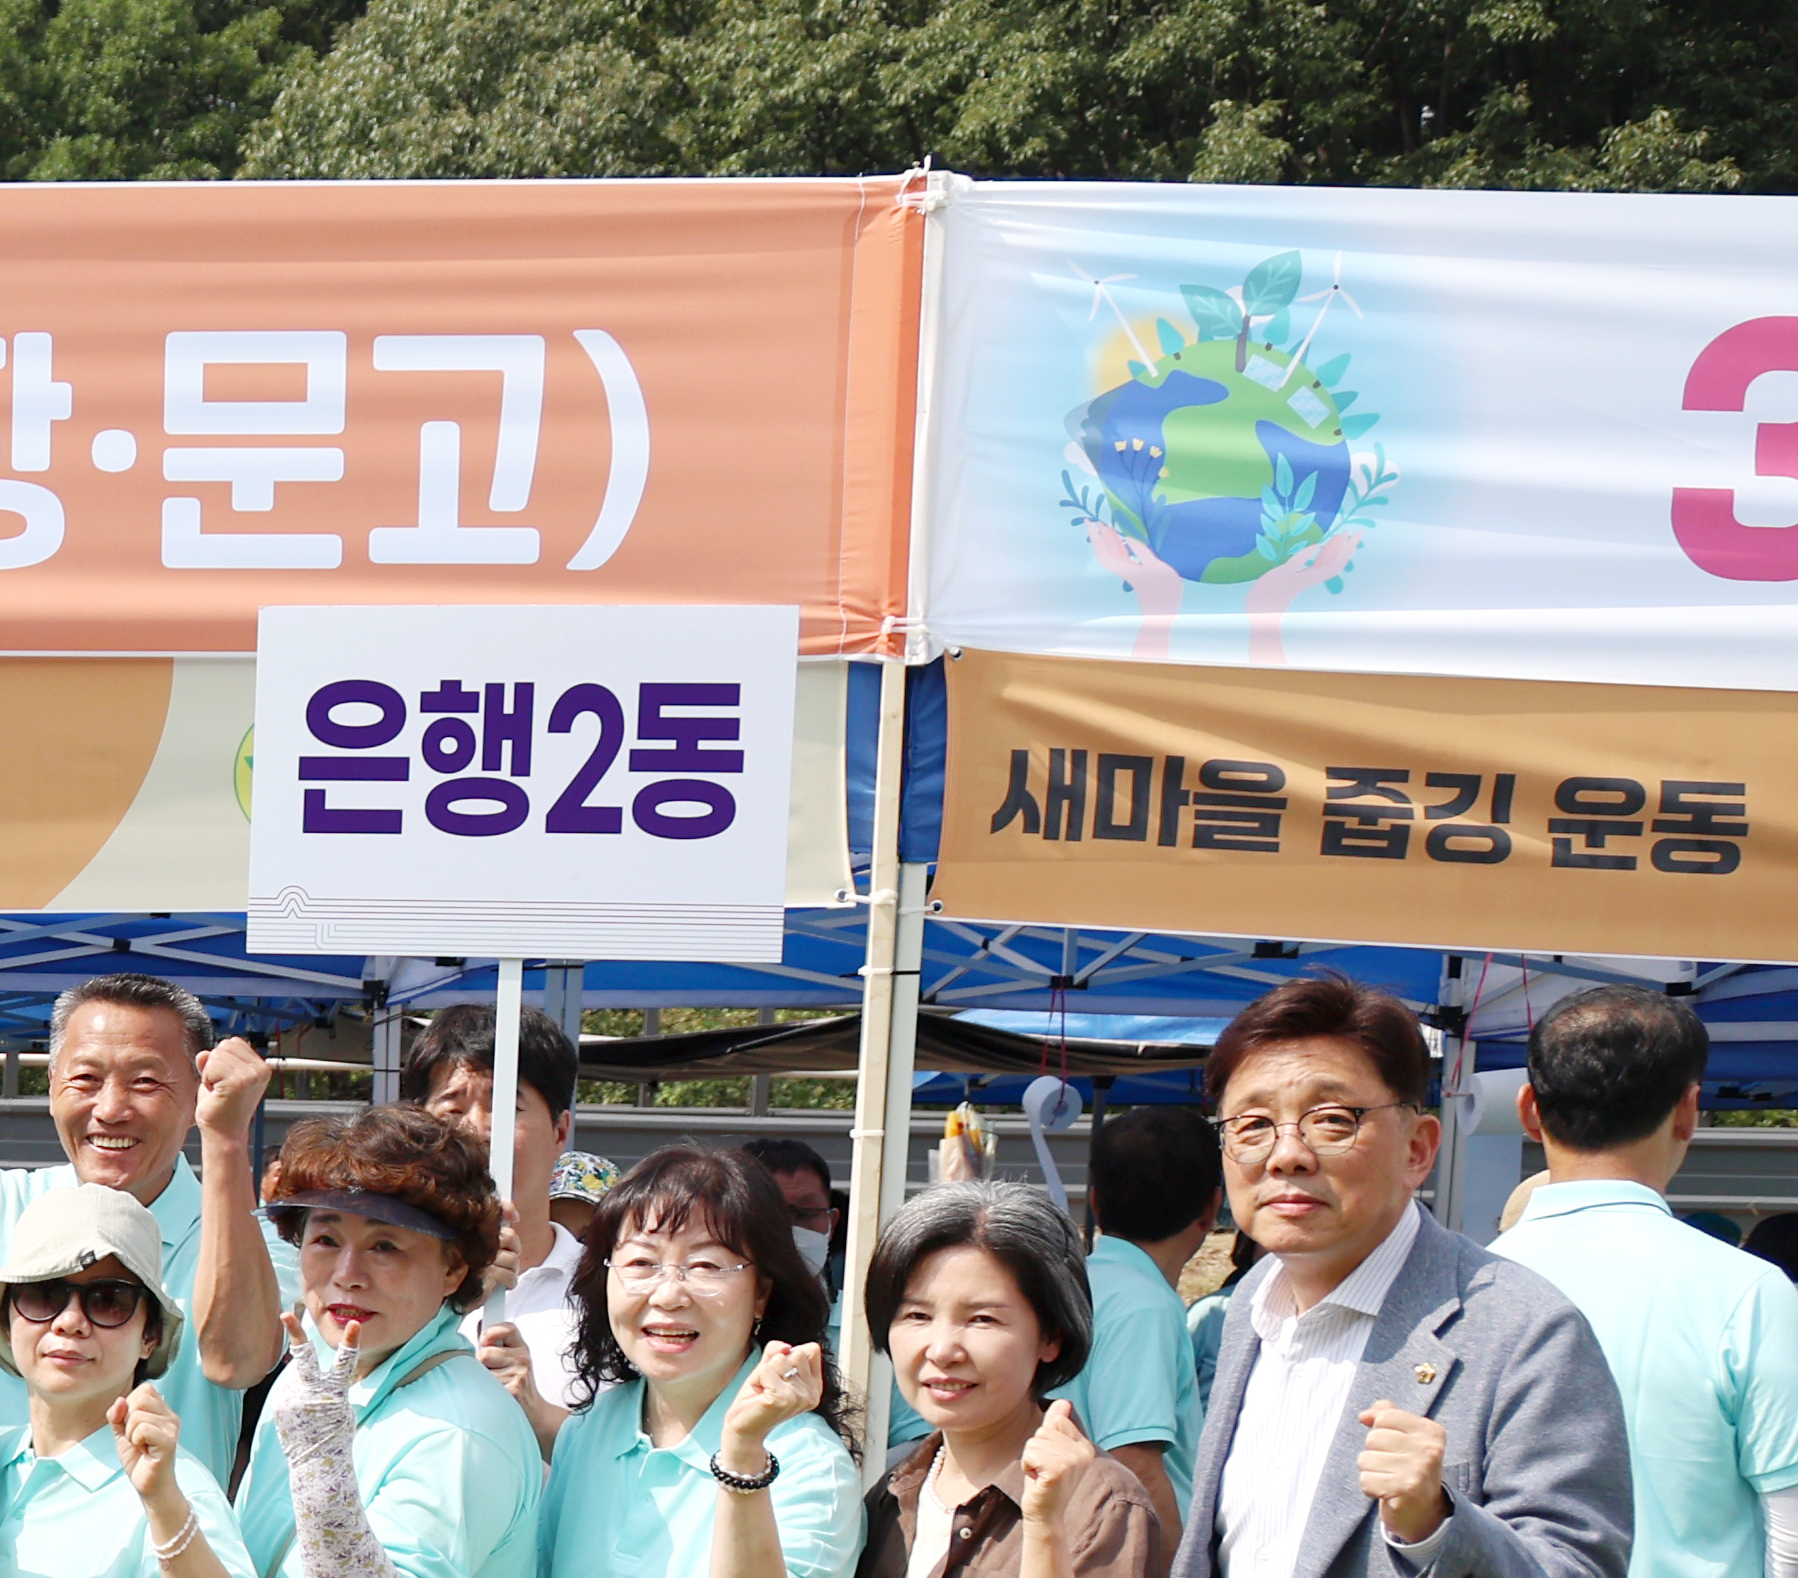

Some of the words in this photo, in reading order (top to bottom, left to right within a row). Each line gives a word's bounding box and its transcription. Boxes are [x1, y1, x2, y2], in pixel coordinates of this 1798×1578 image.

[1671, 316, 1798, 582] 3
[298, 679, 744, 840] 은행2동
[990, 748, 1289, 853] 새마을
[1321, 766, 1513, 865] 줍깅
[1547, 776, 1749, 875] 운동
